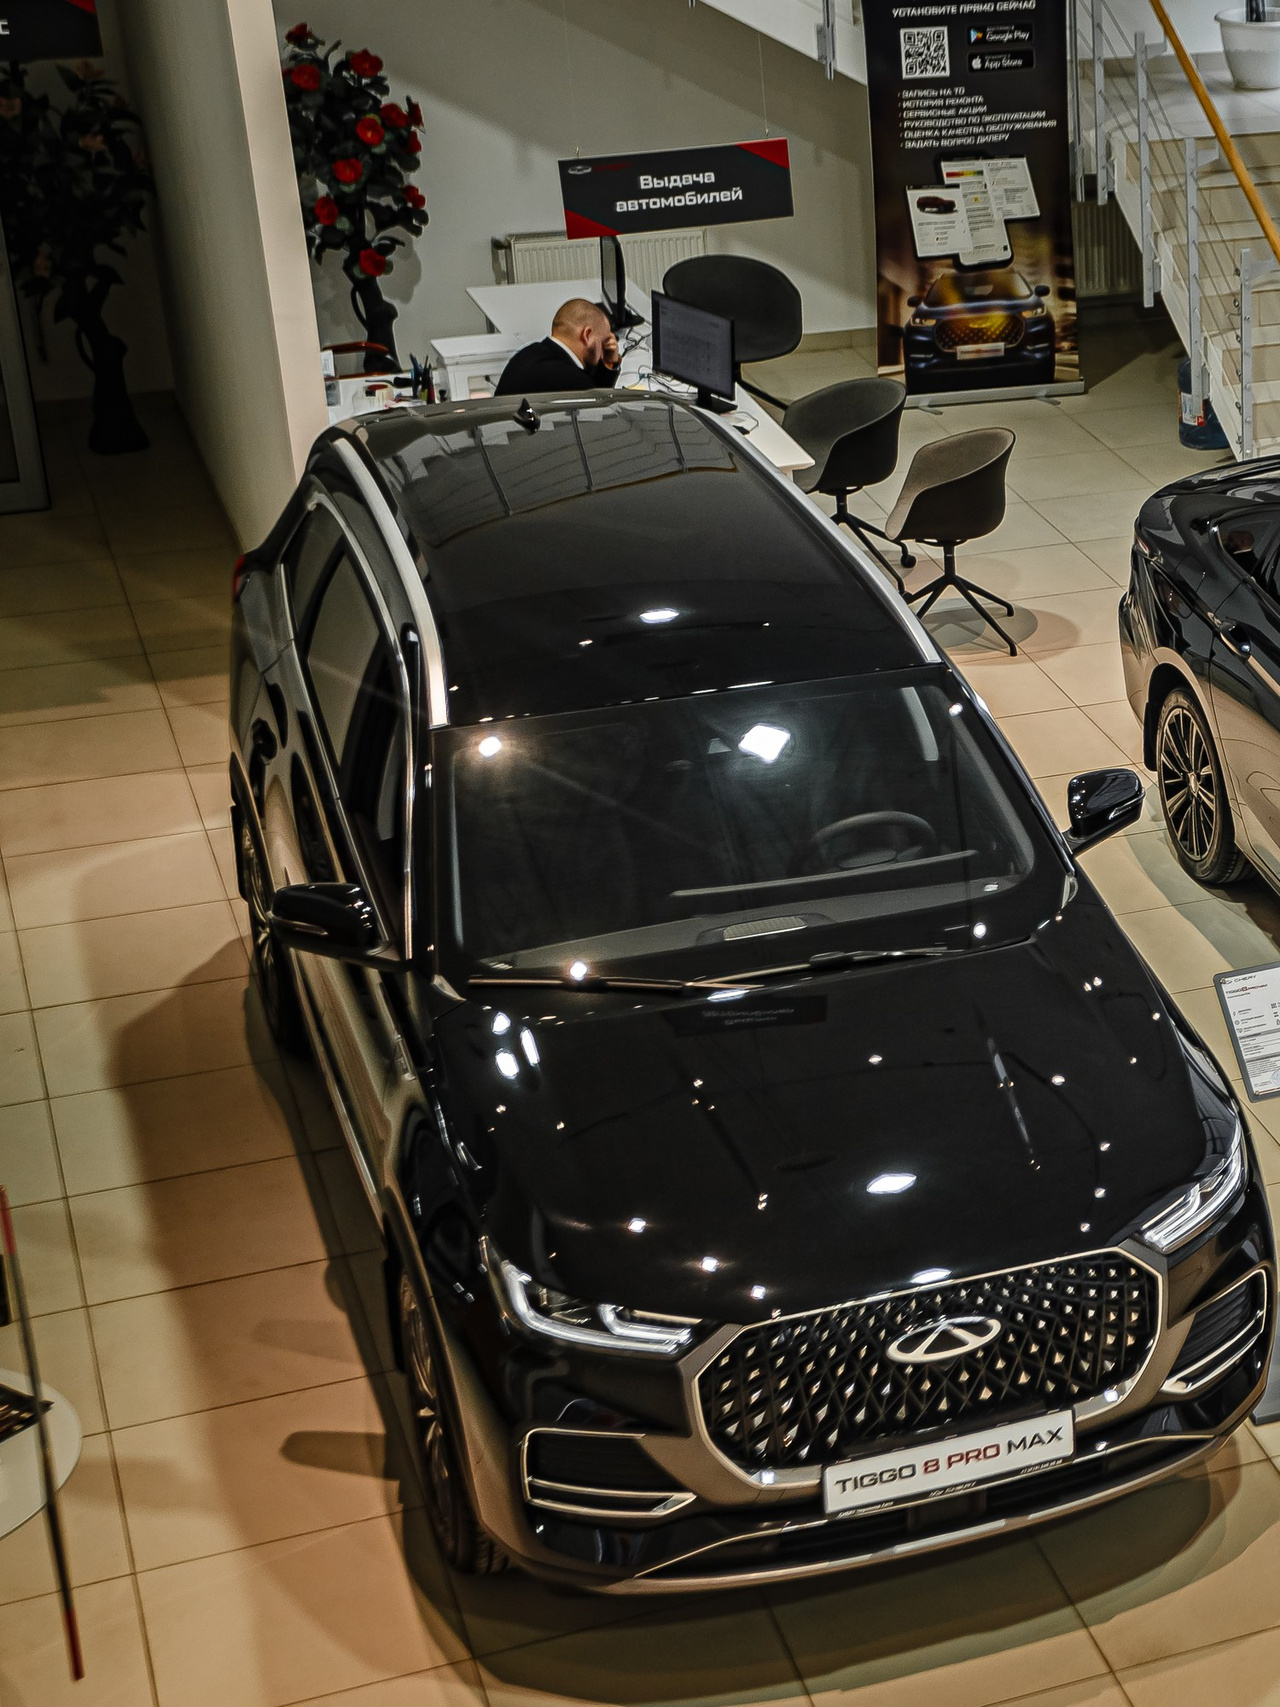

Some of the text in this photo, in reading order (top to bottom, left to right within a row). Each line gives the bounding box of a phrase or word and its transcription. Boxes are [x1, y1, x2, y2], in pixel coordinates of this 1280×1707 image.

[892, 0, 1036, 18] УСТАНОВИТЕ ПРЯМО СЕЙЧАС
[986, 30, 1030, 42] Google Play
[902, 86, 965, 99] ЗАПИСЬ НА ТО
[902, 95, 984, 108] ИСТОРИЯ РЕМОНТА
[903, 105, 987, 118] СЕРВИСНЫЕ АКЦИИ
[904, 110, 1046, 128] РУКОВОДСТВО ПО ЭКСПЛУАТАЦИИ
[904, 120, 1057, 139] ОЦЕНКА КАЧЕСТВА ОБСЛУЖИВАНИЯ
[905, 133, 1010, 149] ЗАДАТЬ ВОПРОС ДИЛЕРУ
[640, 172, 715, 190] Выдача
[616, 187, 743, 213] автомобилей
[834, 1463, 917, 1495] TIGGO
[923, 1457, 940, 1475] 8
[947, 1443, 1001, 1470] PRO
[1007, 1426, 1064, 1456] MAX
